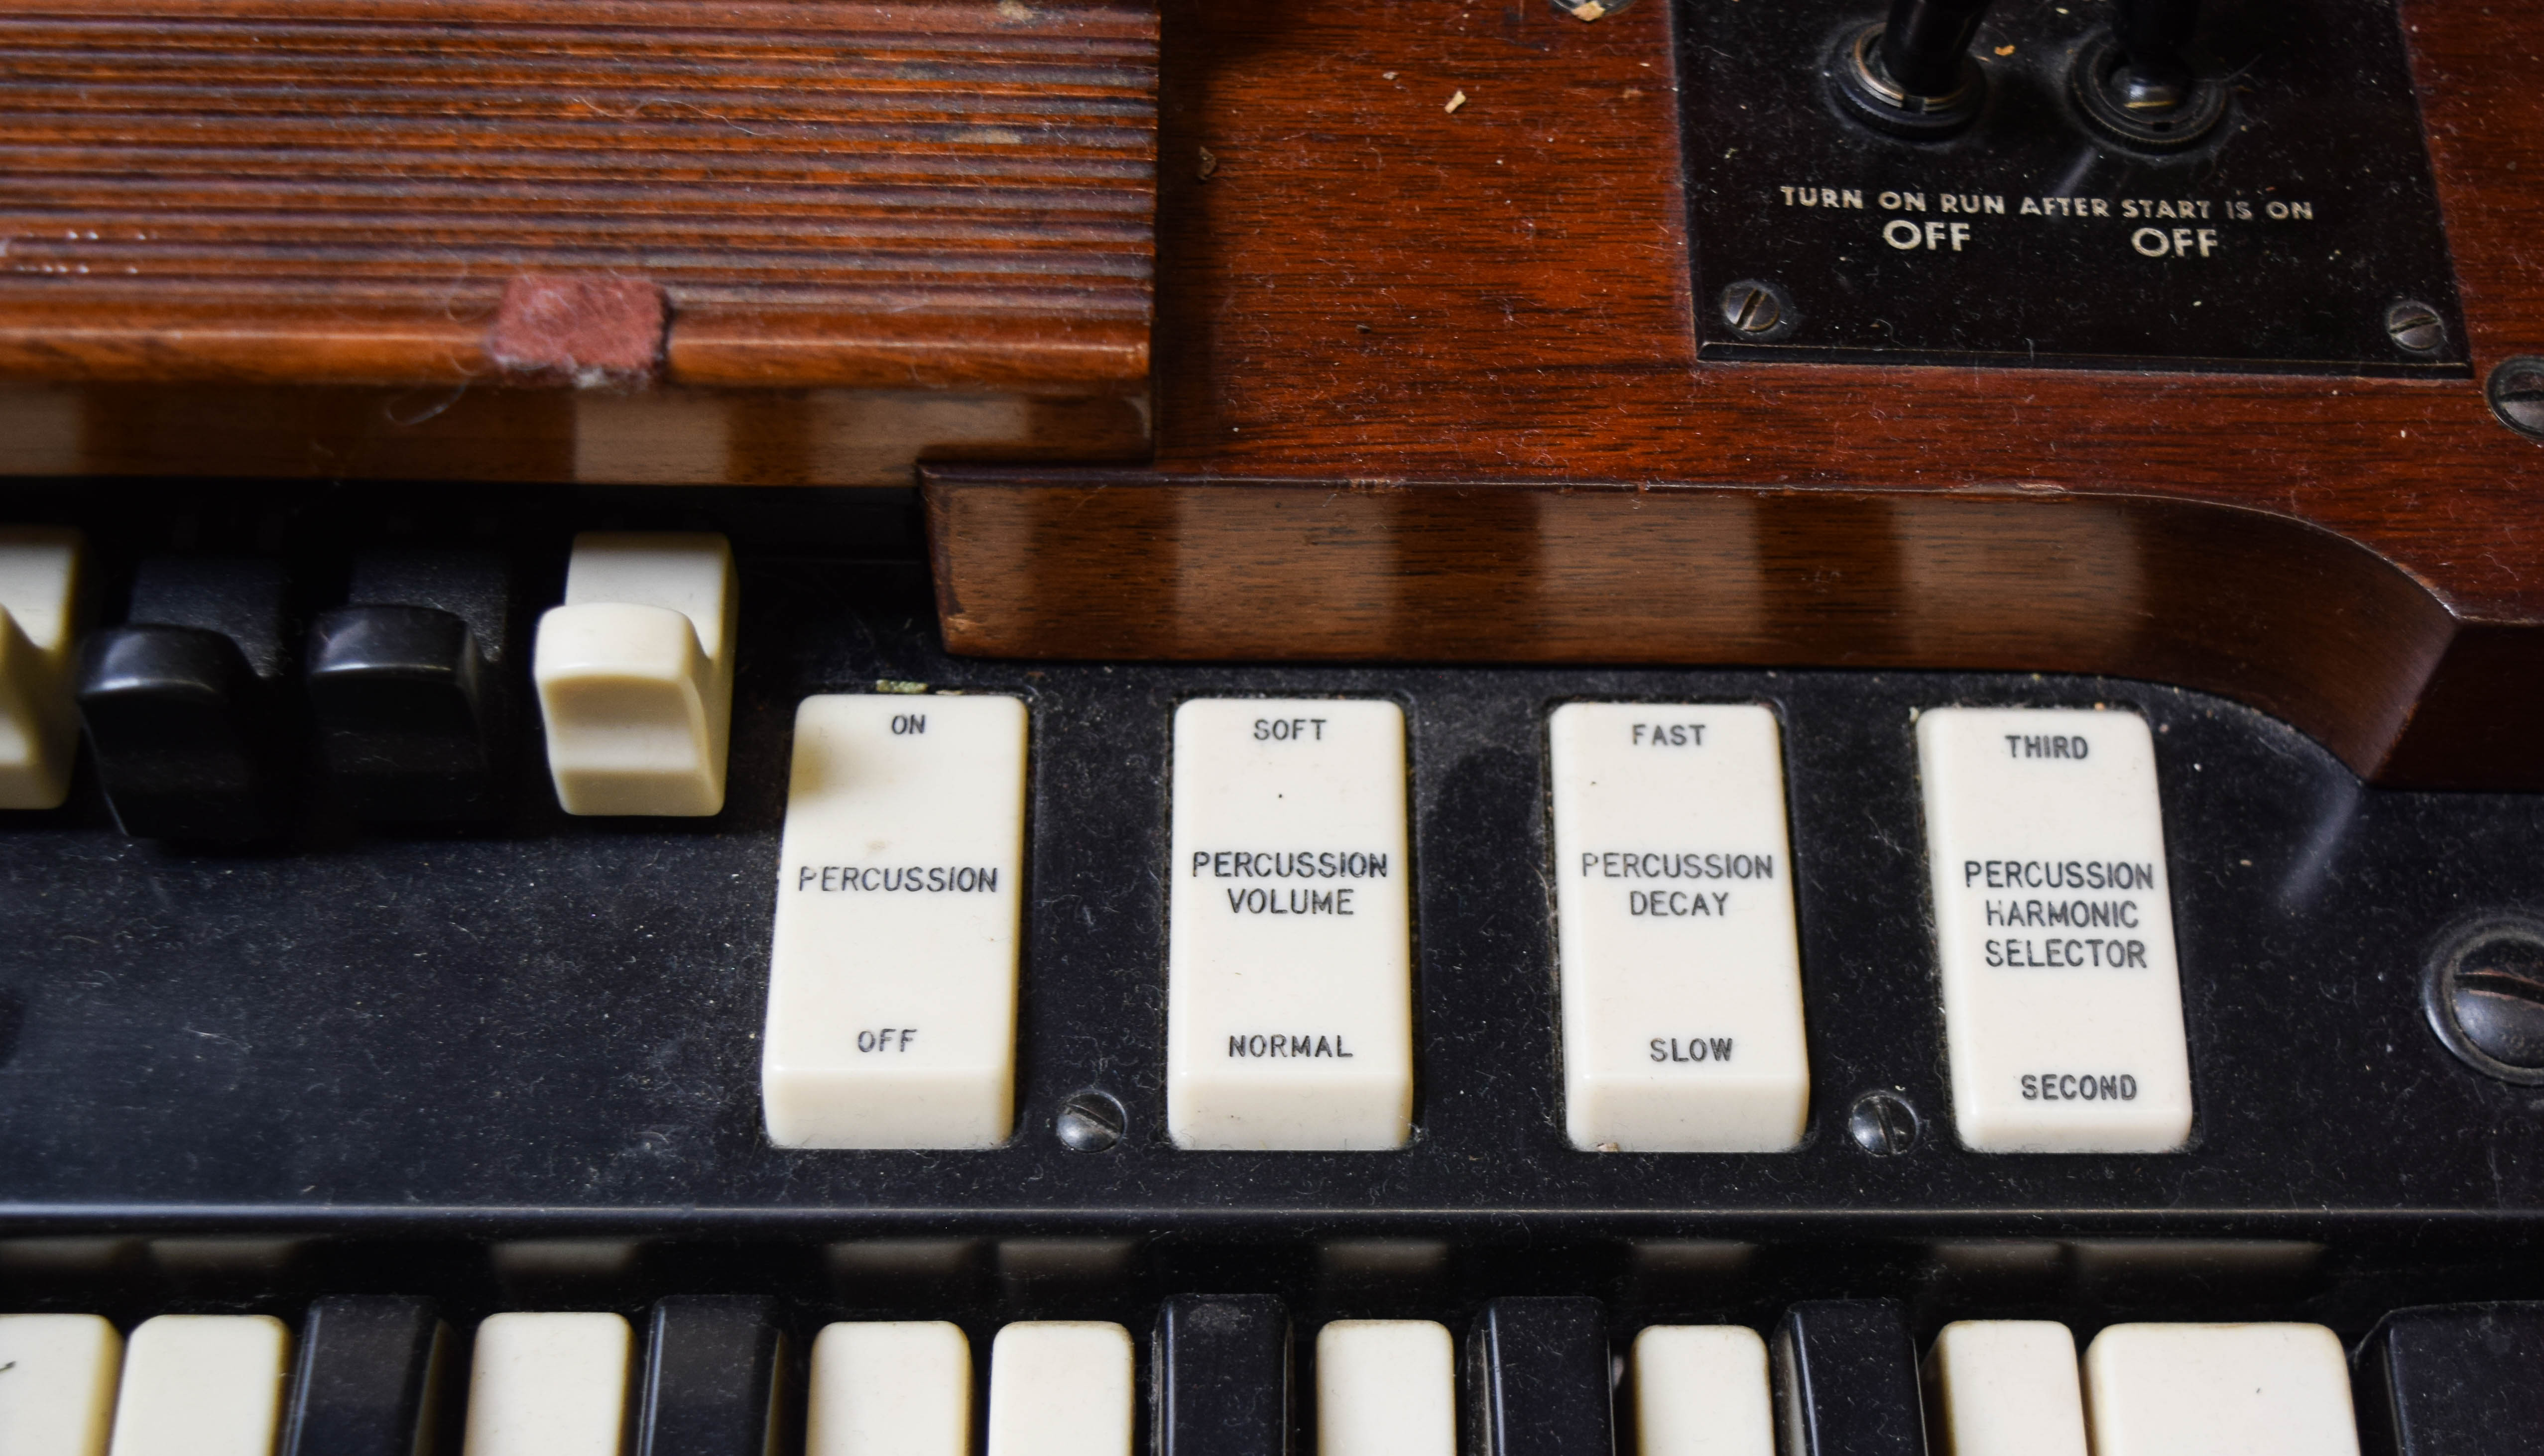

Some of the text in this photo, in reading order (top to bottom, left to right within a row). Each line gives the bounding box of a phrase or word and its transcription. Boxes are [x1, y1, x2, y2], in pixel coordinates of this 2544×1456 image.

[1780, 185, 2313, 220] TURN ON RUN AFTER START IS ON
[1882, 219, 1970, 251] OFF
[2131, 227, 2218, 257] OFF
[890, 713, 926, 736] ON
[1253, 718, 1328, 742] SOFT
[1632, 723, 1706, 747] FAST
[2004, 734, 2089, 761] THIRD
[798, 865, 998, 893] PERCUSSION
[1192, 850, 1388, 879] PERCUSSION
[1581, 851, 1774, 880] PERCUSSION
[1964, 859, 2155, 891] PERCUSSION
[1226, 887, 1354, 916] VOLUME
[1629, 890, 1729, 917] DECAY
[1985, 899, 2139, 929] HARMONIC
[1984, 938, 2148, 969] SELECTOR
[857, 1027, 918, 1053] OFF
[1228, 1033, 1354, 1058] NORMAL
[1650, 1037, 1733, 1063] SLOW
[2020, 1073, 2138, 1102] SECOND
